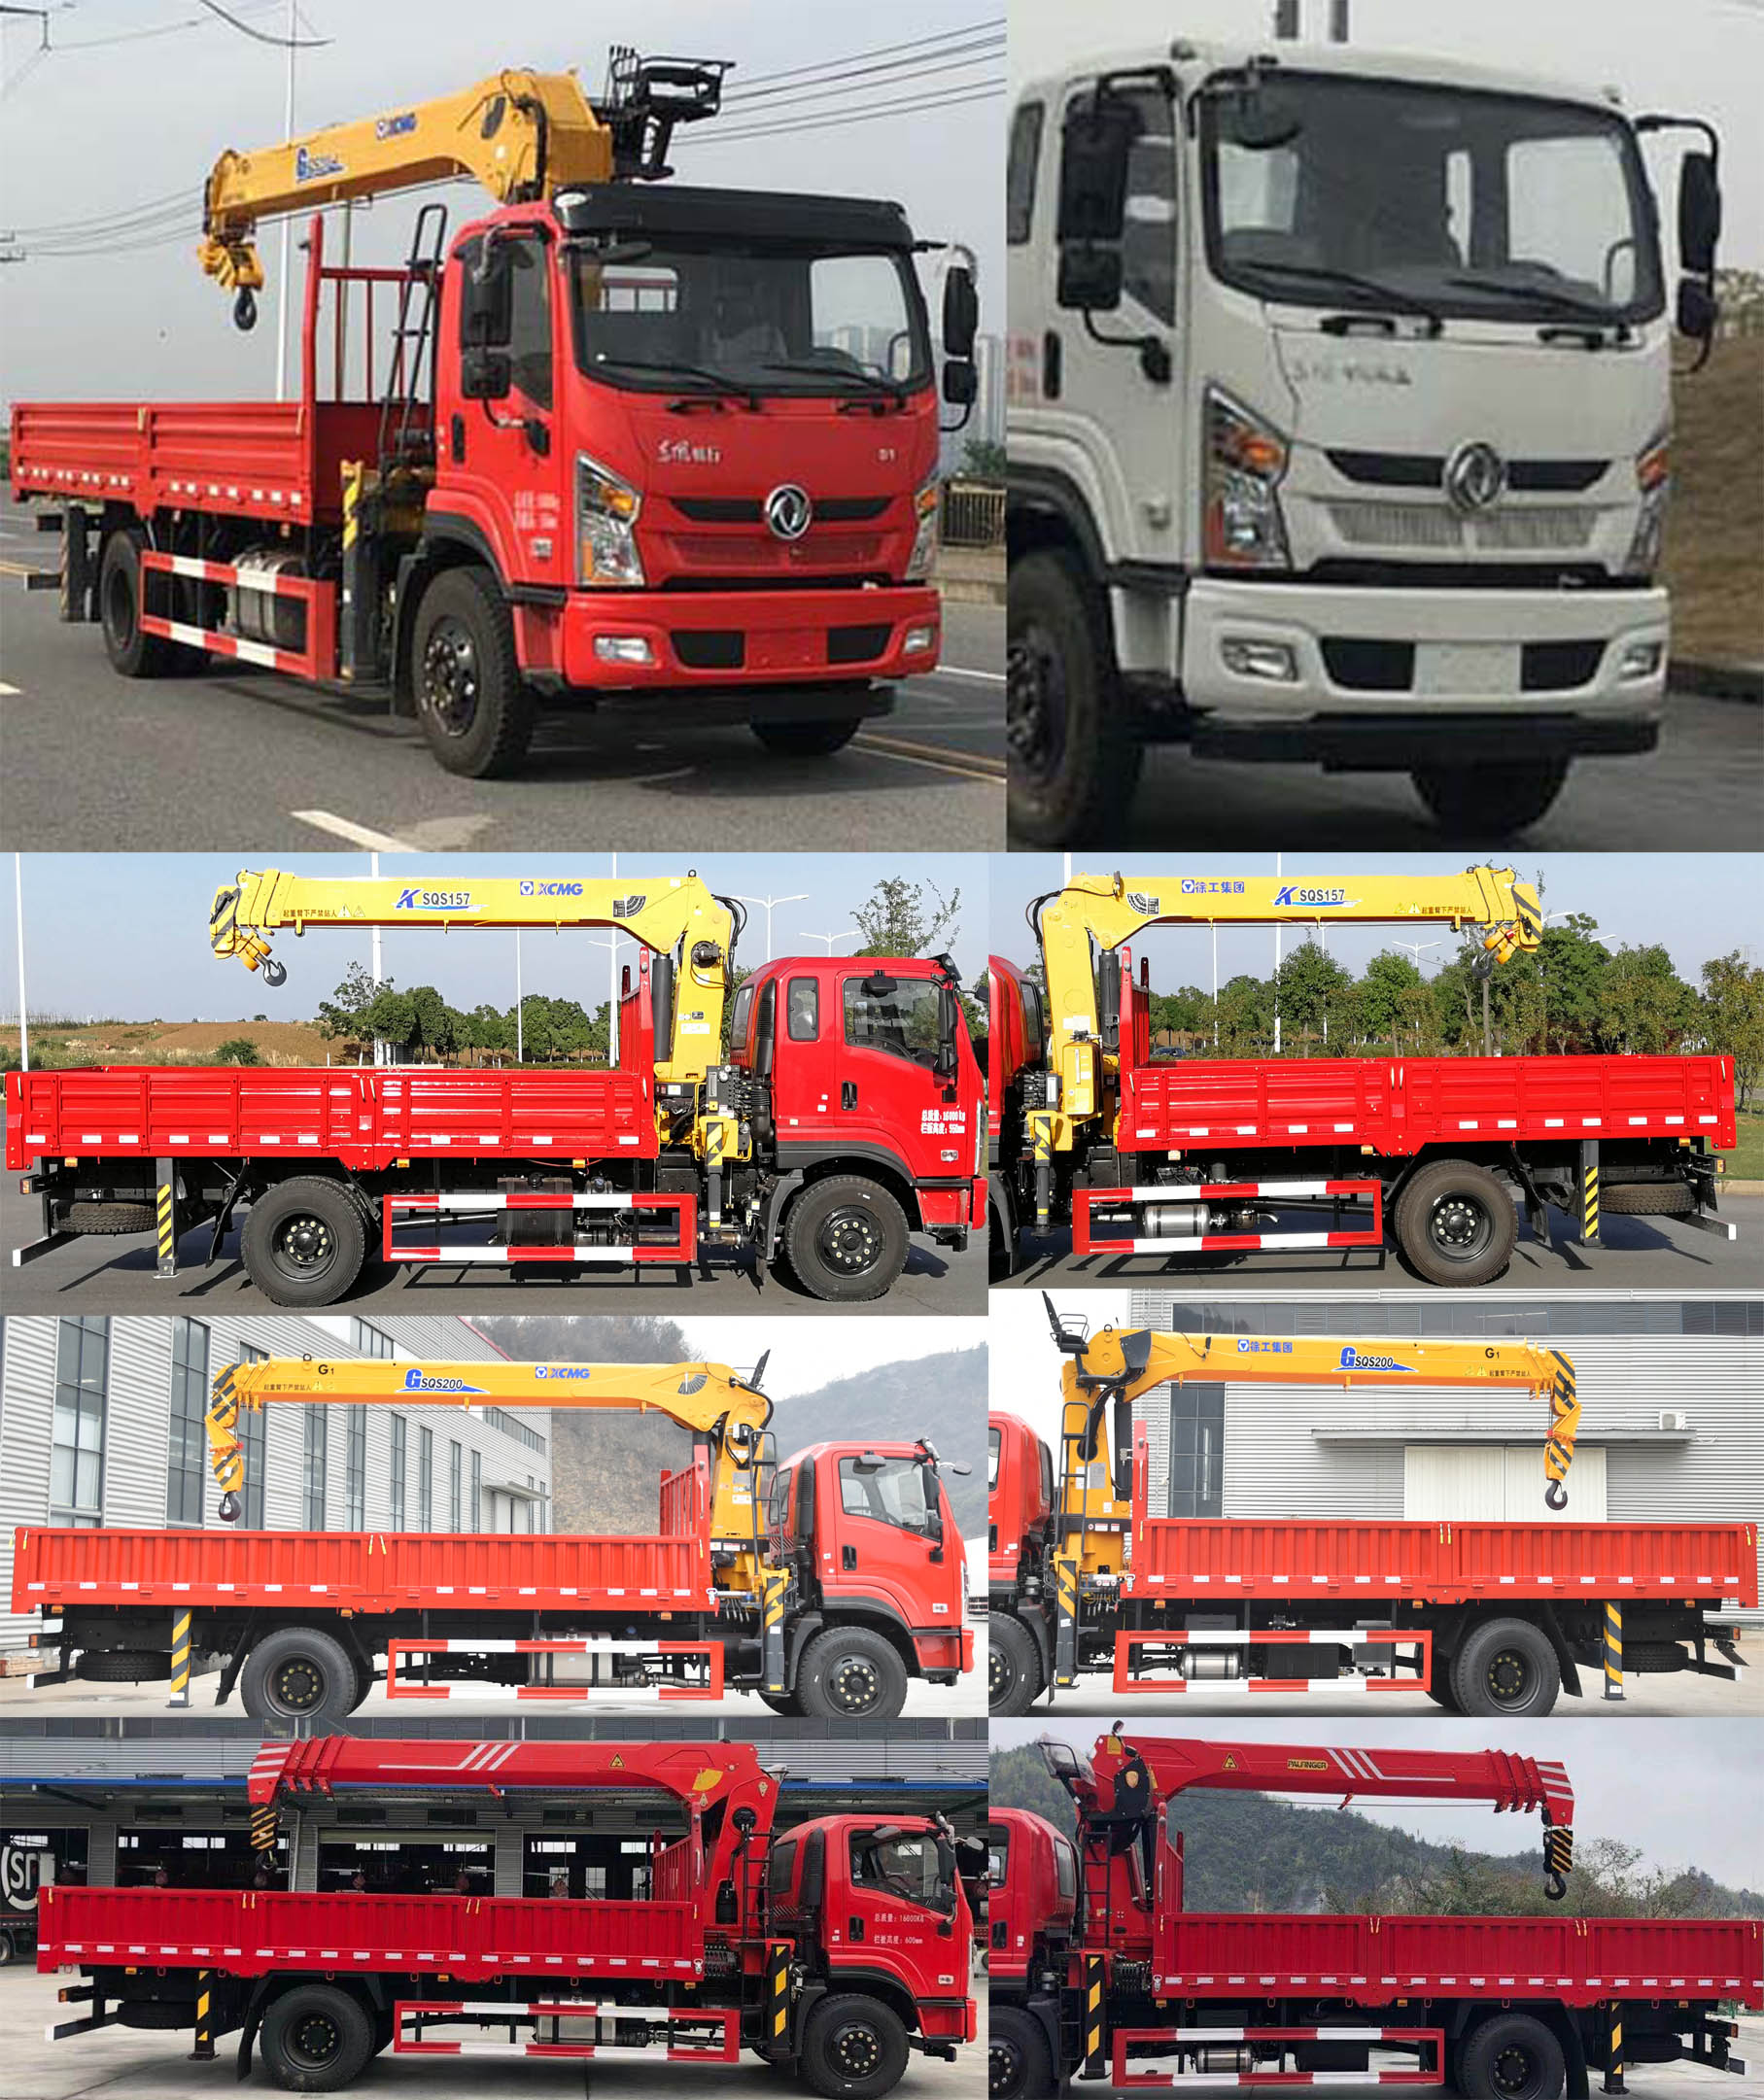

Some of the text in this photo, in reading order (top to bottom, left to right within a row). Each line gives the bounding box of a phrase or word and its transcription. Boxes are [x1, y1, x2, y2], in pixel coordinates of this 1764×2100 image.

[536, 882, 583, 896] XCMG
[1194, 880, 1245, 894] 徐工集团
[549, 1368, 590, 1379] XCMG
[1288, 1760, 1327, 1769] PALFINGER
